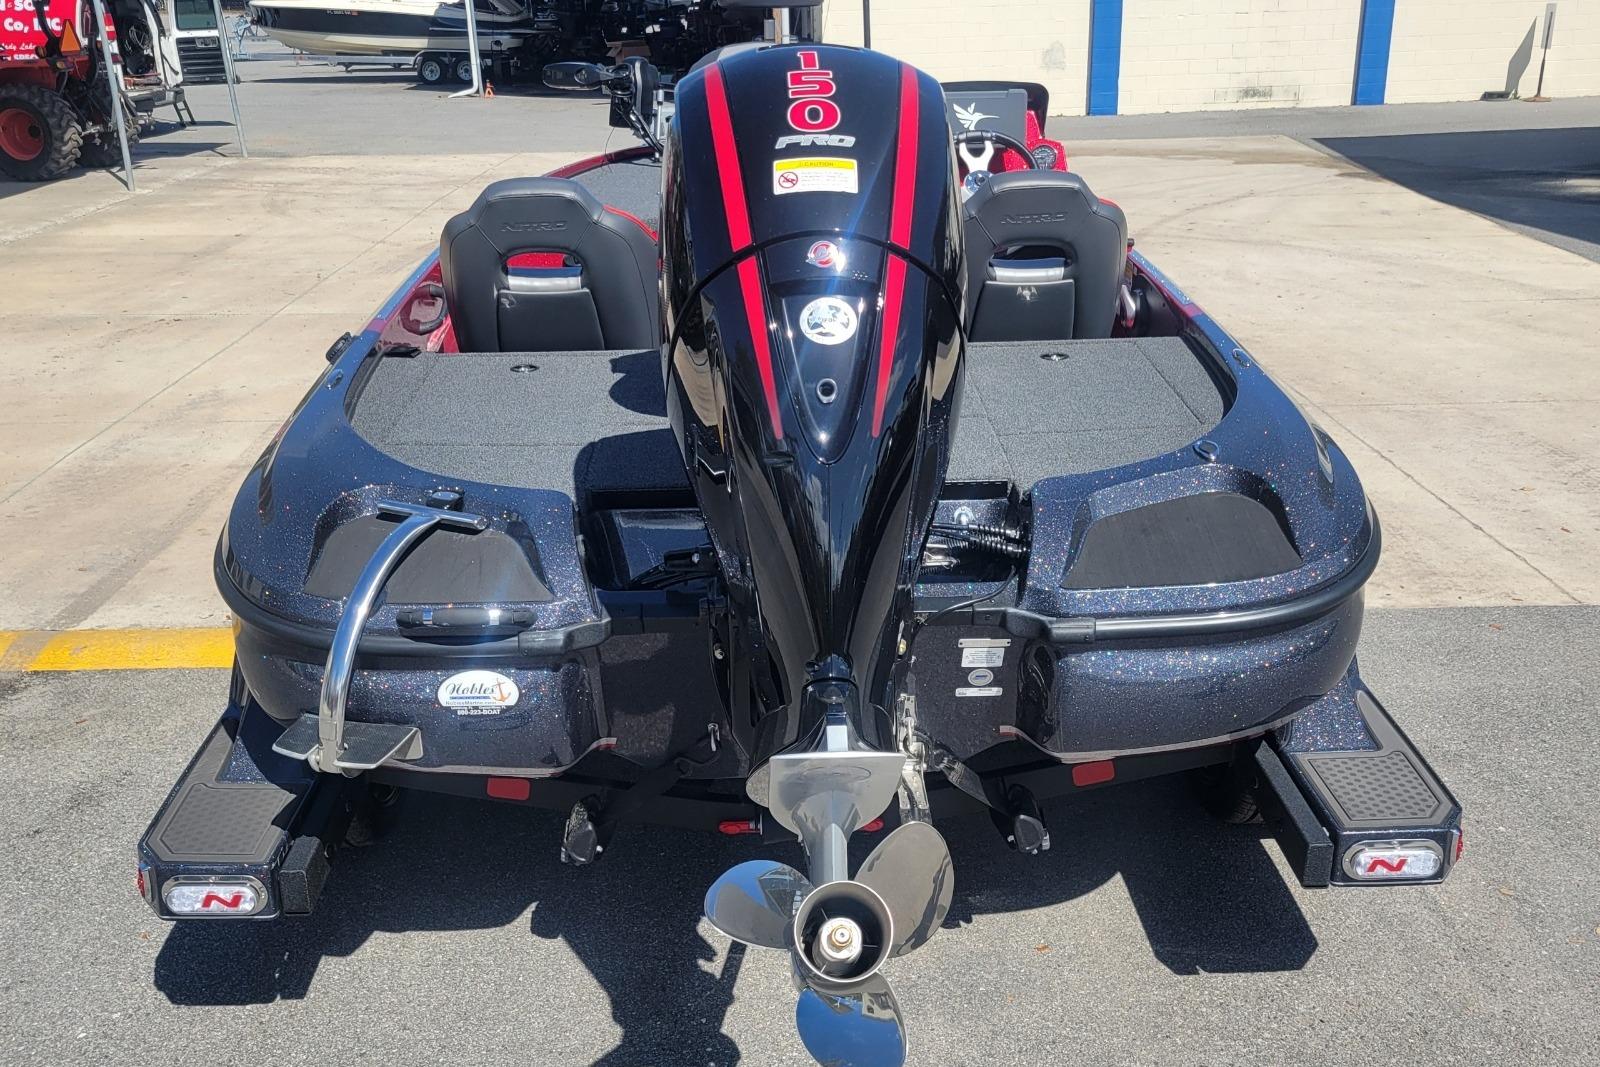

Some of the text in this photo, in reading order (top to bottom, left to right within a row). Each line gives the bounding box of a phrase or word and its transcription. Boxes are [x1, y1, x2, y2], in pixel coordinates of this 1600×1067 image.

[787, 51, 841, 133] 150
[775, 134, 856, 150] PRO
[445, 683, 499, 696] Nobles
